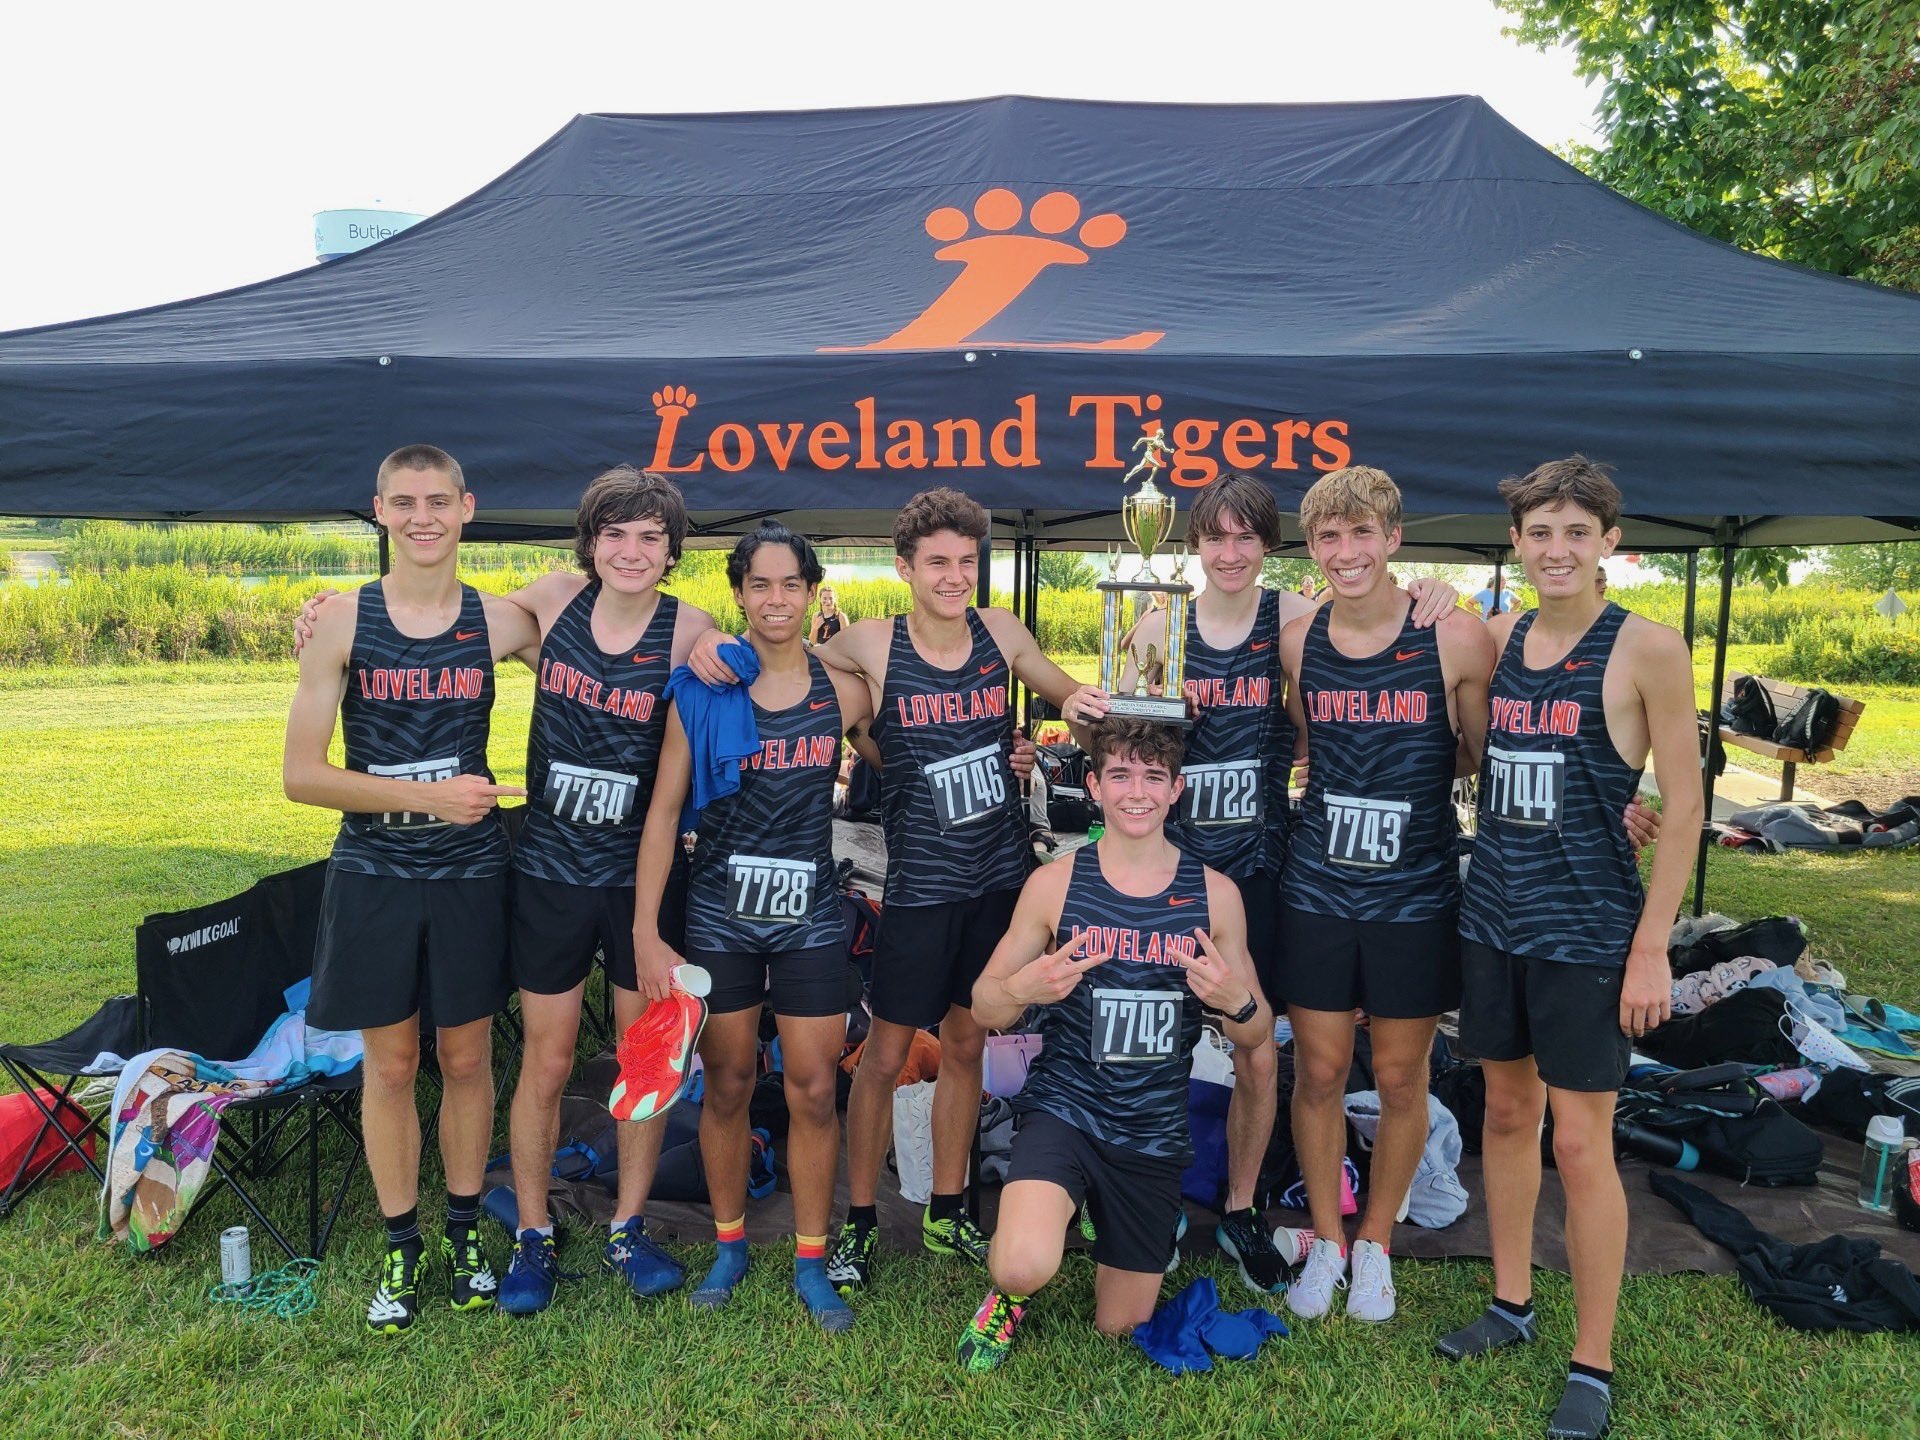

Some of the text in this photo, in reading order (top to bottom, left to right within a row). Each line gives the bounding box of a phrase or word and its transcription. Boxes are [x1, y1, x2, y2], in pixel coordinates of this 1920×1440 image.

[349, 223, 398, 239] Butler
[643, 389, 1351, 488] Loveland Tigers
[359, 667, 484, 700] LOVELAND
[540, 657, 655, 723] LOVELAND
[898, 685, 1007, 727] LOVELAND
[1184, 676, 1270, 707] OVELAND
[1307, 690, 1428, 723] LOVELAND
[1490, 696, 1580, 736] OVELAND
[739, 735, 836, 770] VELAND
[552, 773, 627, 826] 7734
[935, 755, 1007, 819] 7746
[1186, 769, 1257, 819] 7722
[1490, 758, 1556, 820] 7744
[1327, 805, 1401, 862] 7743
[735, 866, 809, 917] 7728
[1071, 925, 1196, 967] LOVELAND
[1100, 1000, 1175, 1054] 7742
